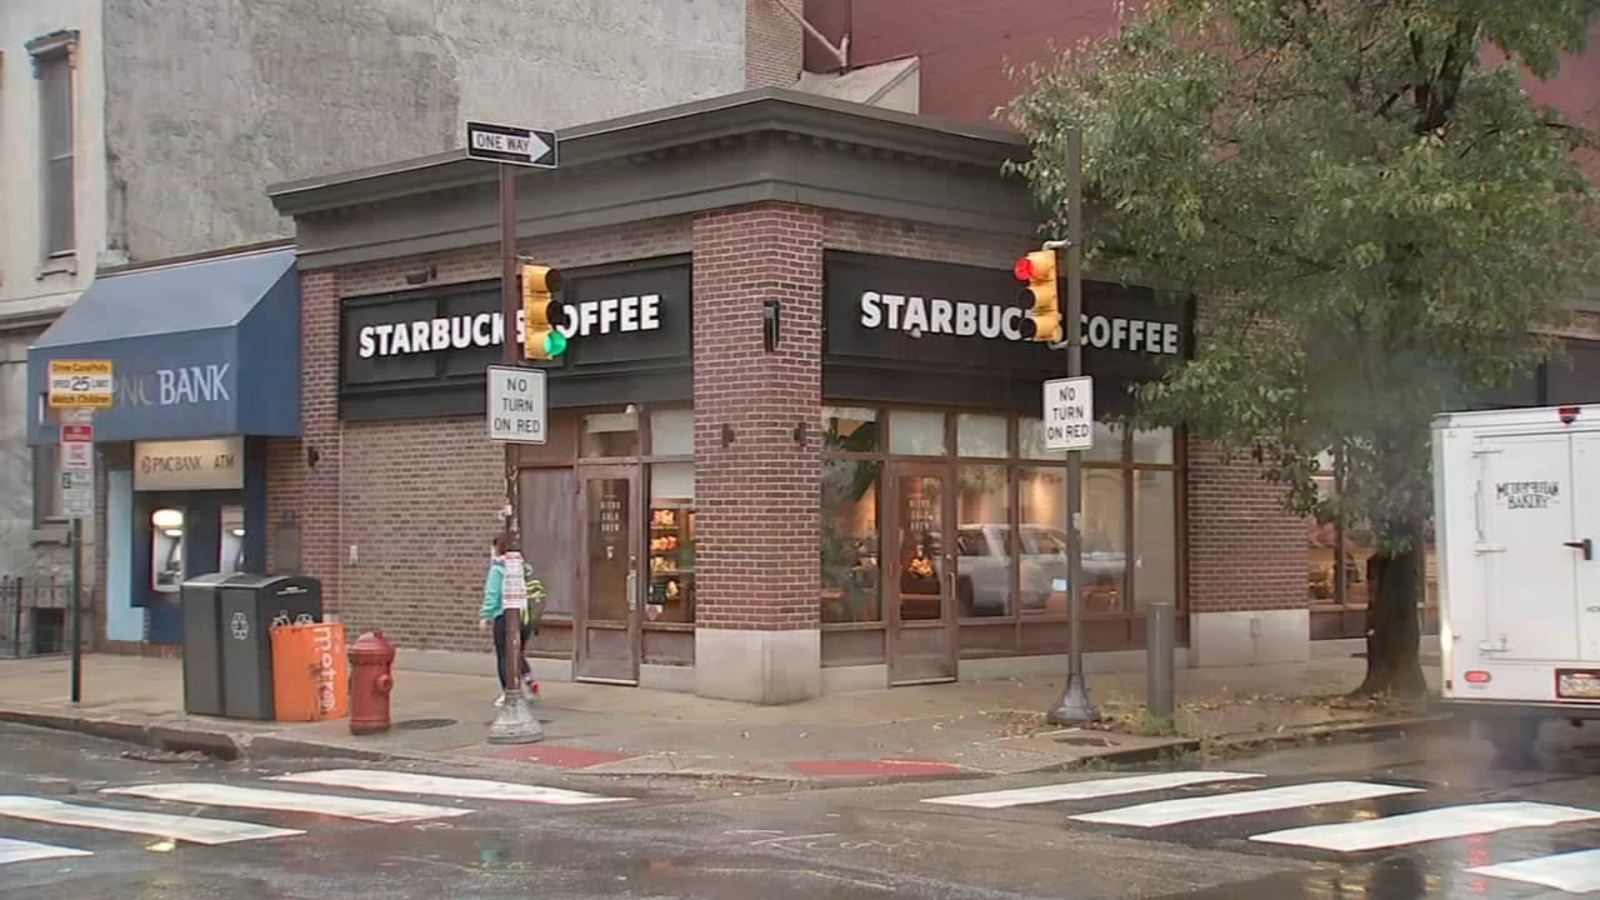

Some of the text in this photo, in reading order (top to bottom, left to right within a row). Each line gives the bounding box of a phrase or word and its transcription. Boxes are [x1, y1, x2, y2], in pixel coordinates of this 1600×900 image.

[476, 133, 531, 151] ONE WAY
[548, 294, 660, 341] OFFEE
[861, 291, 1063, 342] STARBUC
[71, 375, 90, 391] 25
[156, 363, 230, 406] BANK
[507, 378, 527, 392] NO
[1059, 386, 1075, 401] NO
[502, 397, 534, 412] TURN
[1052, 405, 1084, 420] TURN
[494, 417, 540, 433] ON RED
[1048, 423, 1089, 440] ON RED
[213, 454, 236, 470] ATM
